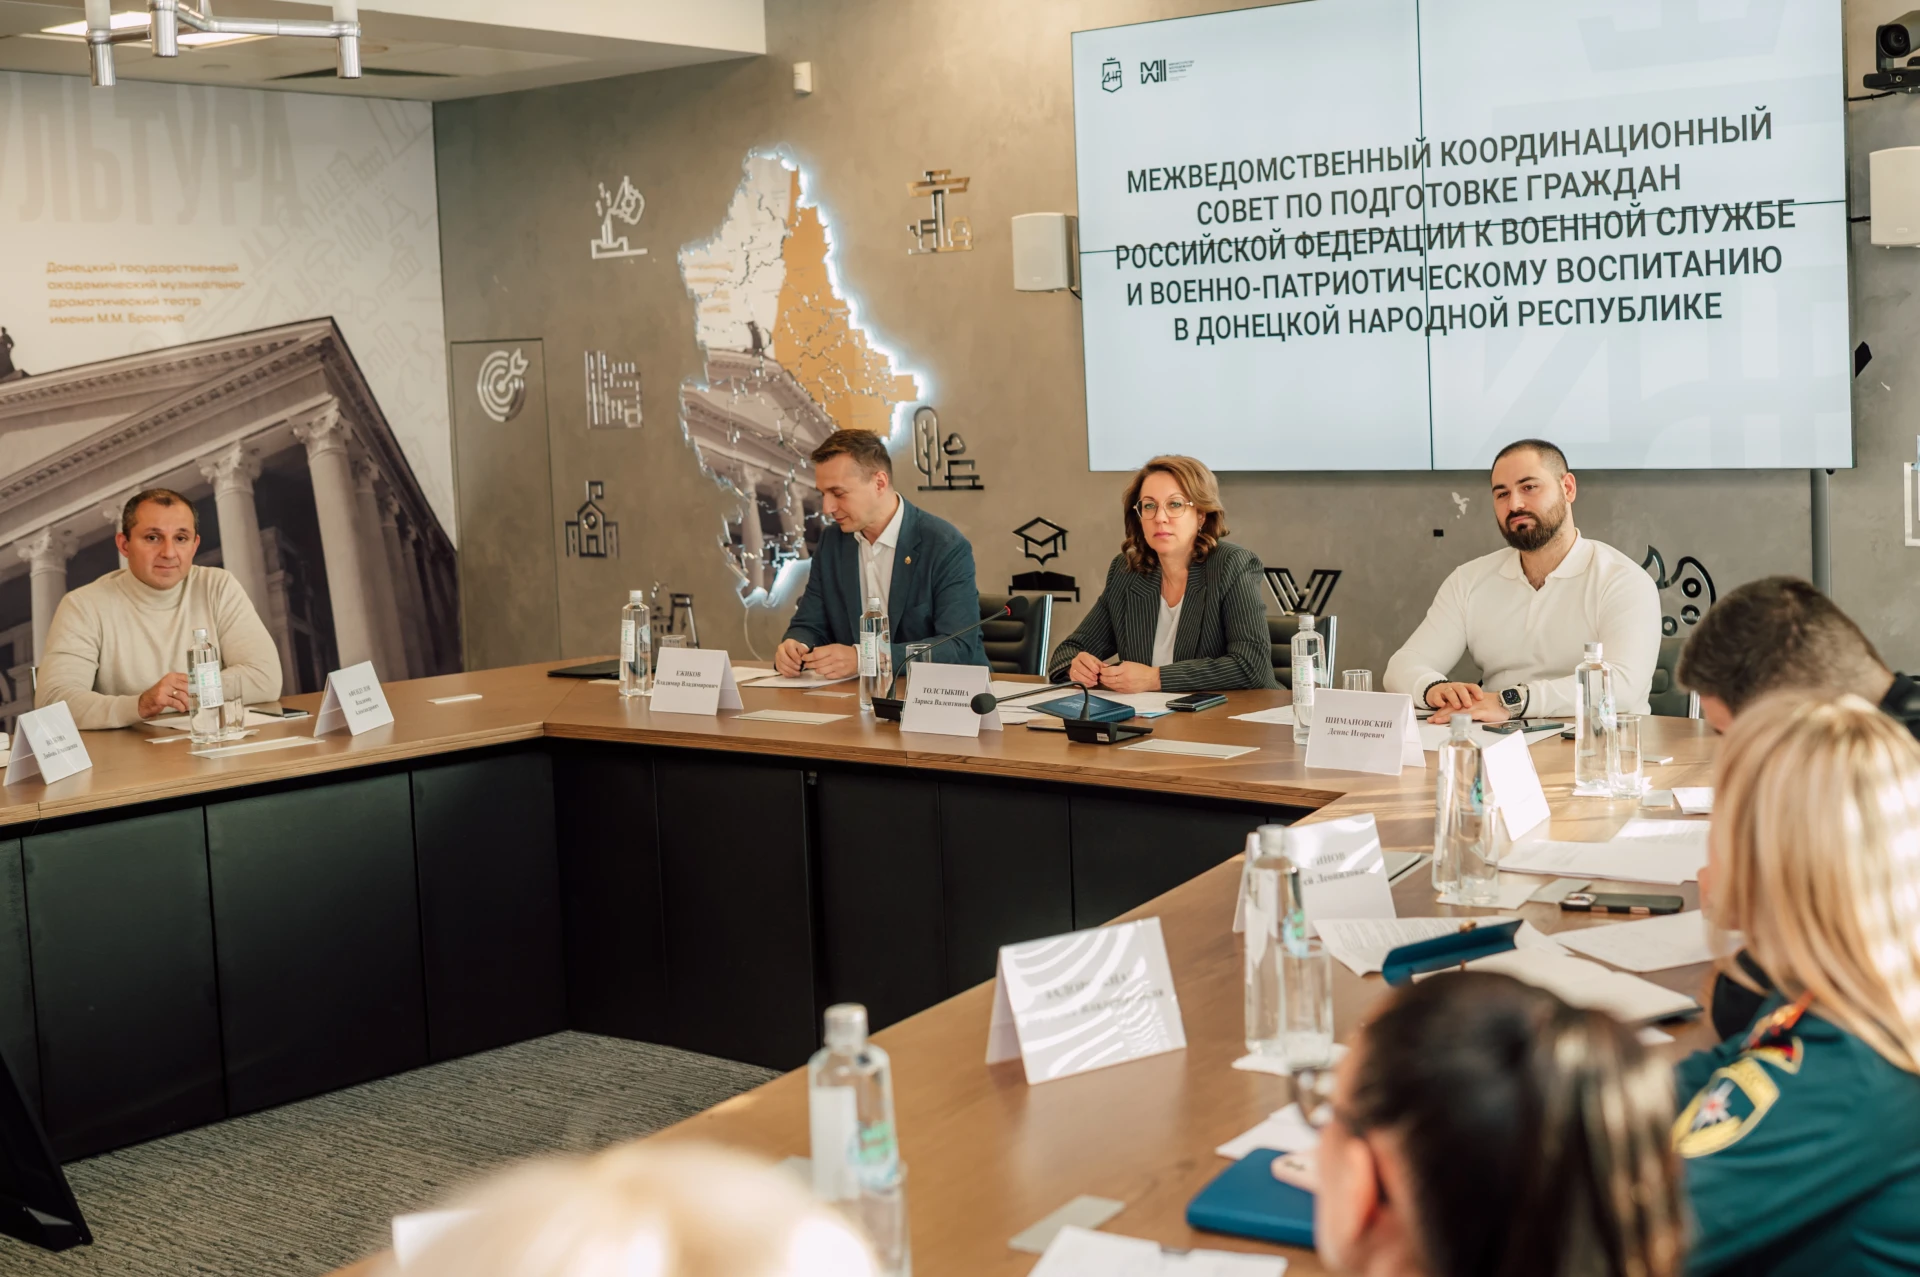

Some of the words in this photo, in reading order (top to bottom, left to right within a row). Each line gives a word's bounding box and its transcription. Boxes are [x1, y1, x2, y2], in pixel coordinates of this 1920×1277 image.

[0, 73, 305, 227] ЛЬТУРА
[1127, 136, 1431, 193] МЕЖВЕДОМСТВЕННЫЙ
[1441, 105, 1772, 167] КООРДИНАЦИОННЫЙ
[1197, 194, 1279, 225] СОВЕТ
[1286, 192, 1322, 219] ПО
[1331, 178, 1518, 219] ПОДГОТОВКЕ
[1528, 164, 1681, 201] ГРАЖДАН
[1115, 227, 1287, 270] РОССИЙСКОЙ
[1294, 221, 1465, 262] ФЕДЕРАЦИИ
[1475, 219, 1493, 247] К
[1502, 202, 1646, 245] ВОЕННОЙ
[1656, 198, 1796, 237] СЛУЖБЕ
[46, 262, 117, 273] Донецкий
[120, 263, 239, 274] государственный
[1127, 282, 1143, 306] И
[1151, 258, 1548, 305] ВОЕННО-ПАТРИОТИЧЕСКОМУ
[1557, 245, 1783, 284] ВОСПИТАНИЮ
[47, 279, 158, 291] академический
[160, 281, 246, 292] музыкально-
[49, 296, 159, 309] драматический
[163, 298, 202, 308] театр
[50, 315, 95, 324] имени
[1174, 317, 1189, 341] В
[1196, 304, 1340, 346] ДОНЕЦКОЙ
[1348, 296, 1508, 337] НАРОДНОЙ
[1519, 292, 1722, 327] РЕСПУБЛИКЕ
[656, 679, 680, 688] Владимир
[681, 681, 719, 690] Владимирович
[923, 687, 969, 697] ТОЛСТЫКИНА
[912, 697, 934, 706] Лариса
[1325, 716, 1393, 729] ШИМАНОВСКИЙ
[1327, 728, 1349, 737] Денис
[1350, 729, 1385, 740] Игоревич
